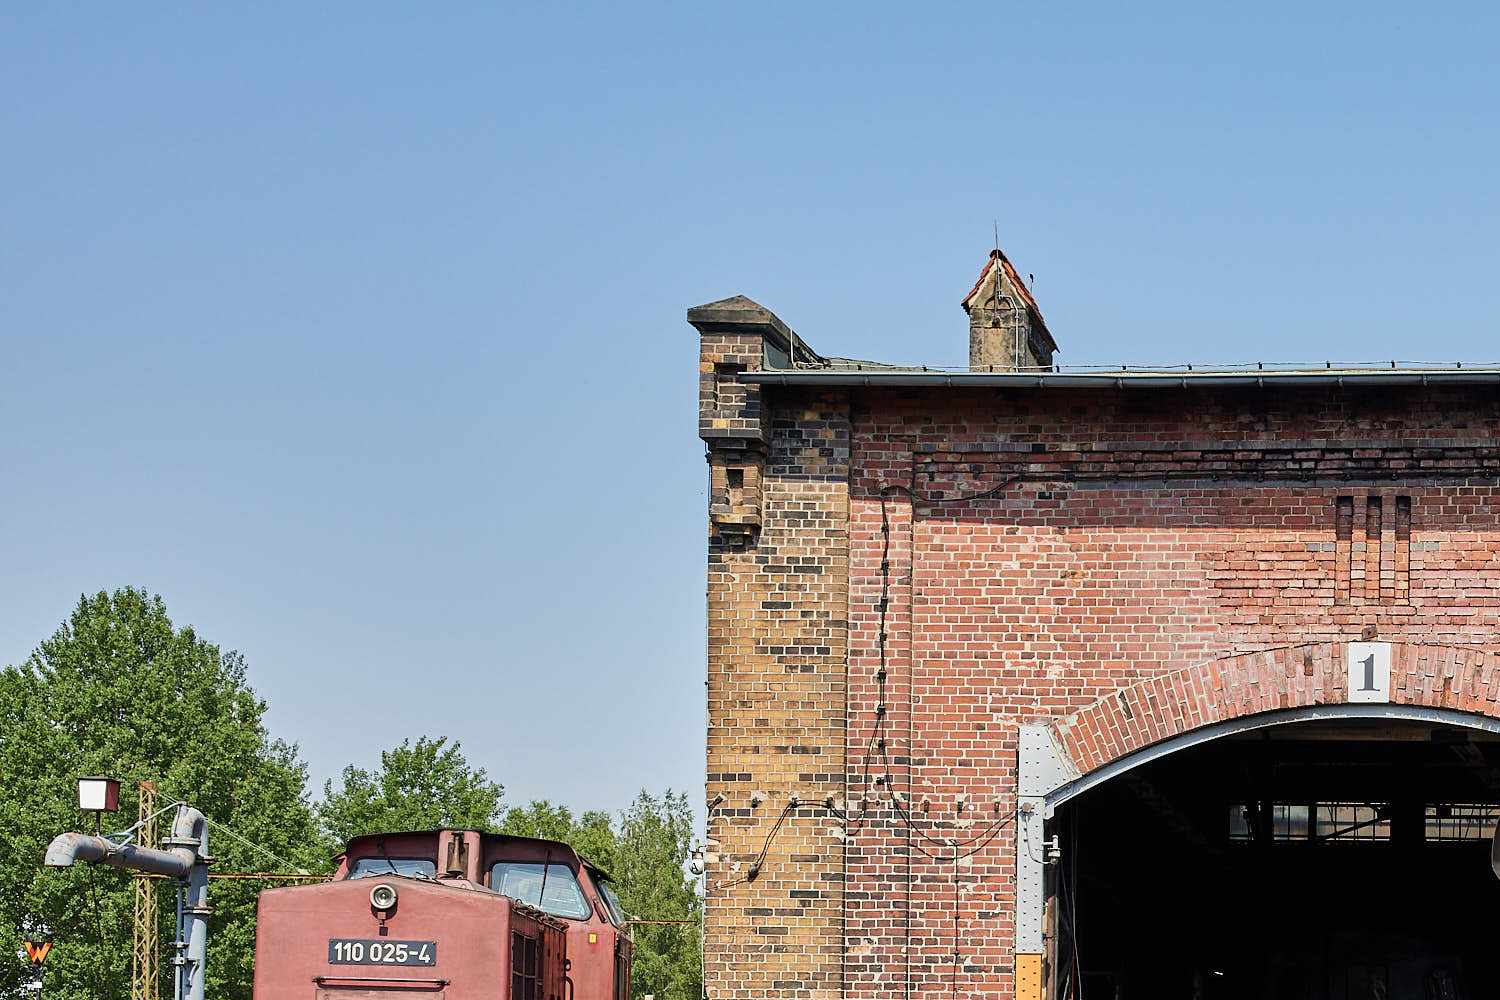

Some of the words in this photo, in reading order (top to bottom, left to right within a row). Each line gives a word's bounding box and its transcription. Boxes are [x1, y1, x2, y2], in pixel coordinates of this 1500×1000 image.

[1356, 653, 1381, 692] 1
[334, 942, 364, 962] 110
[369, 943, 431, 964] 025-4
